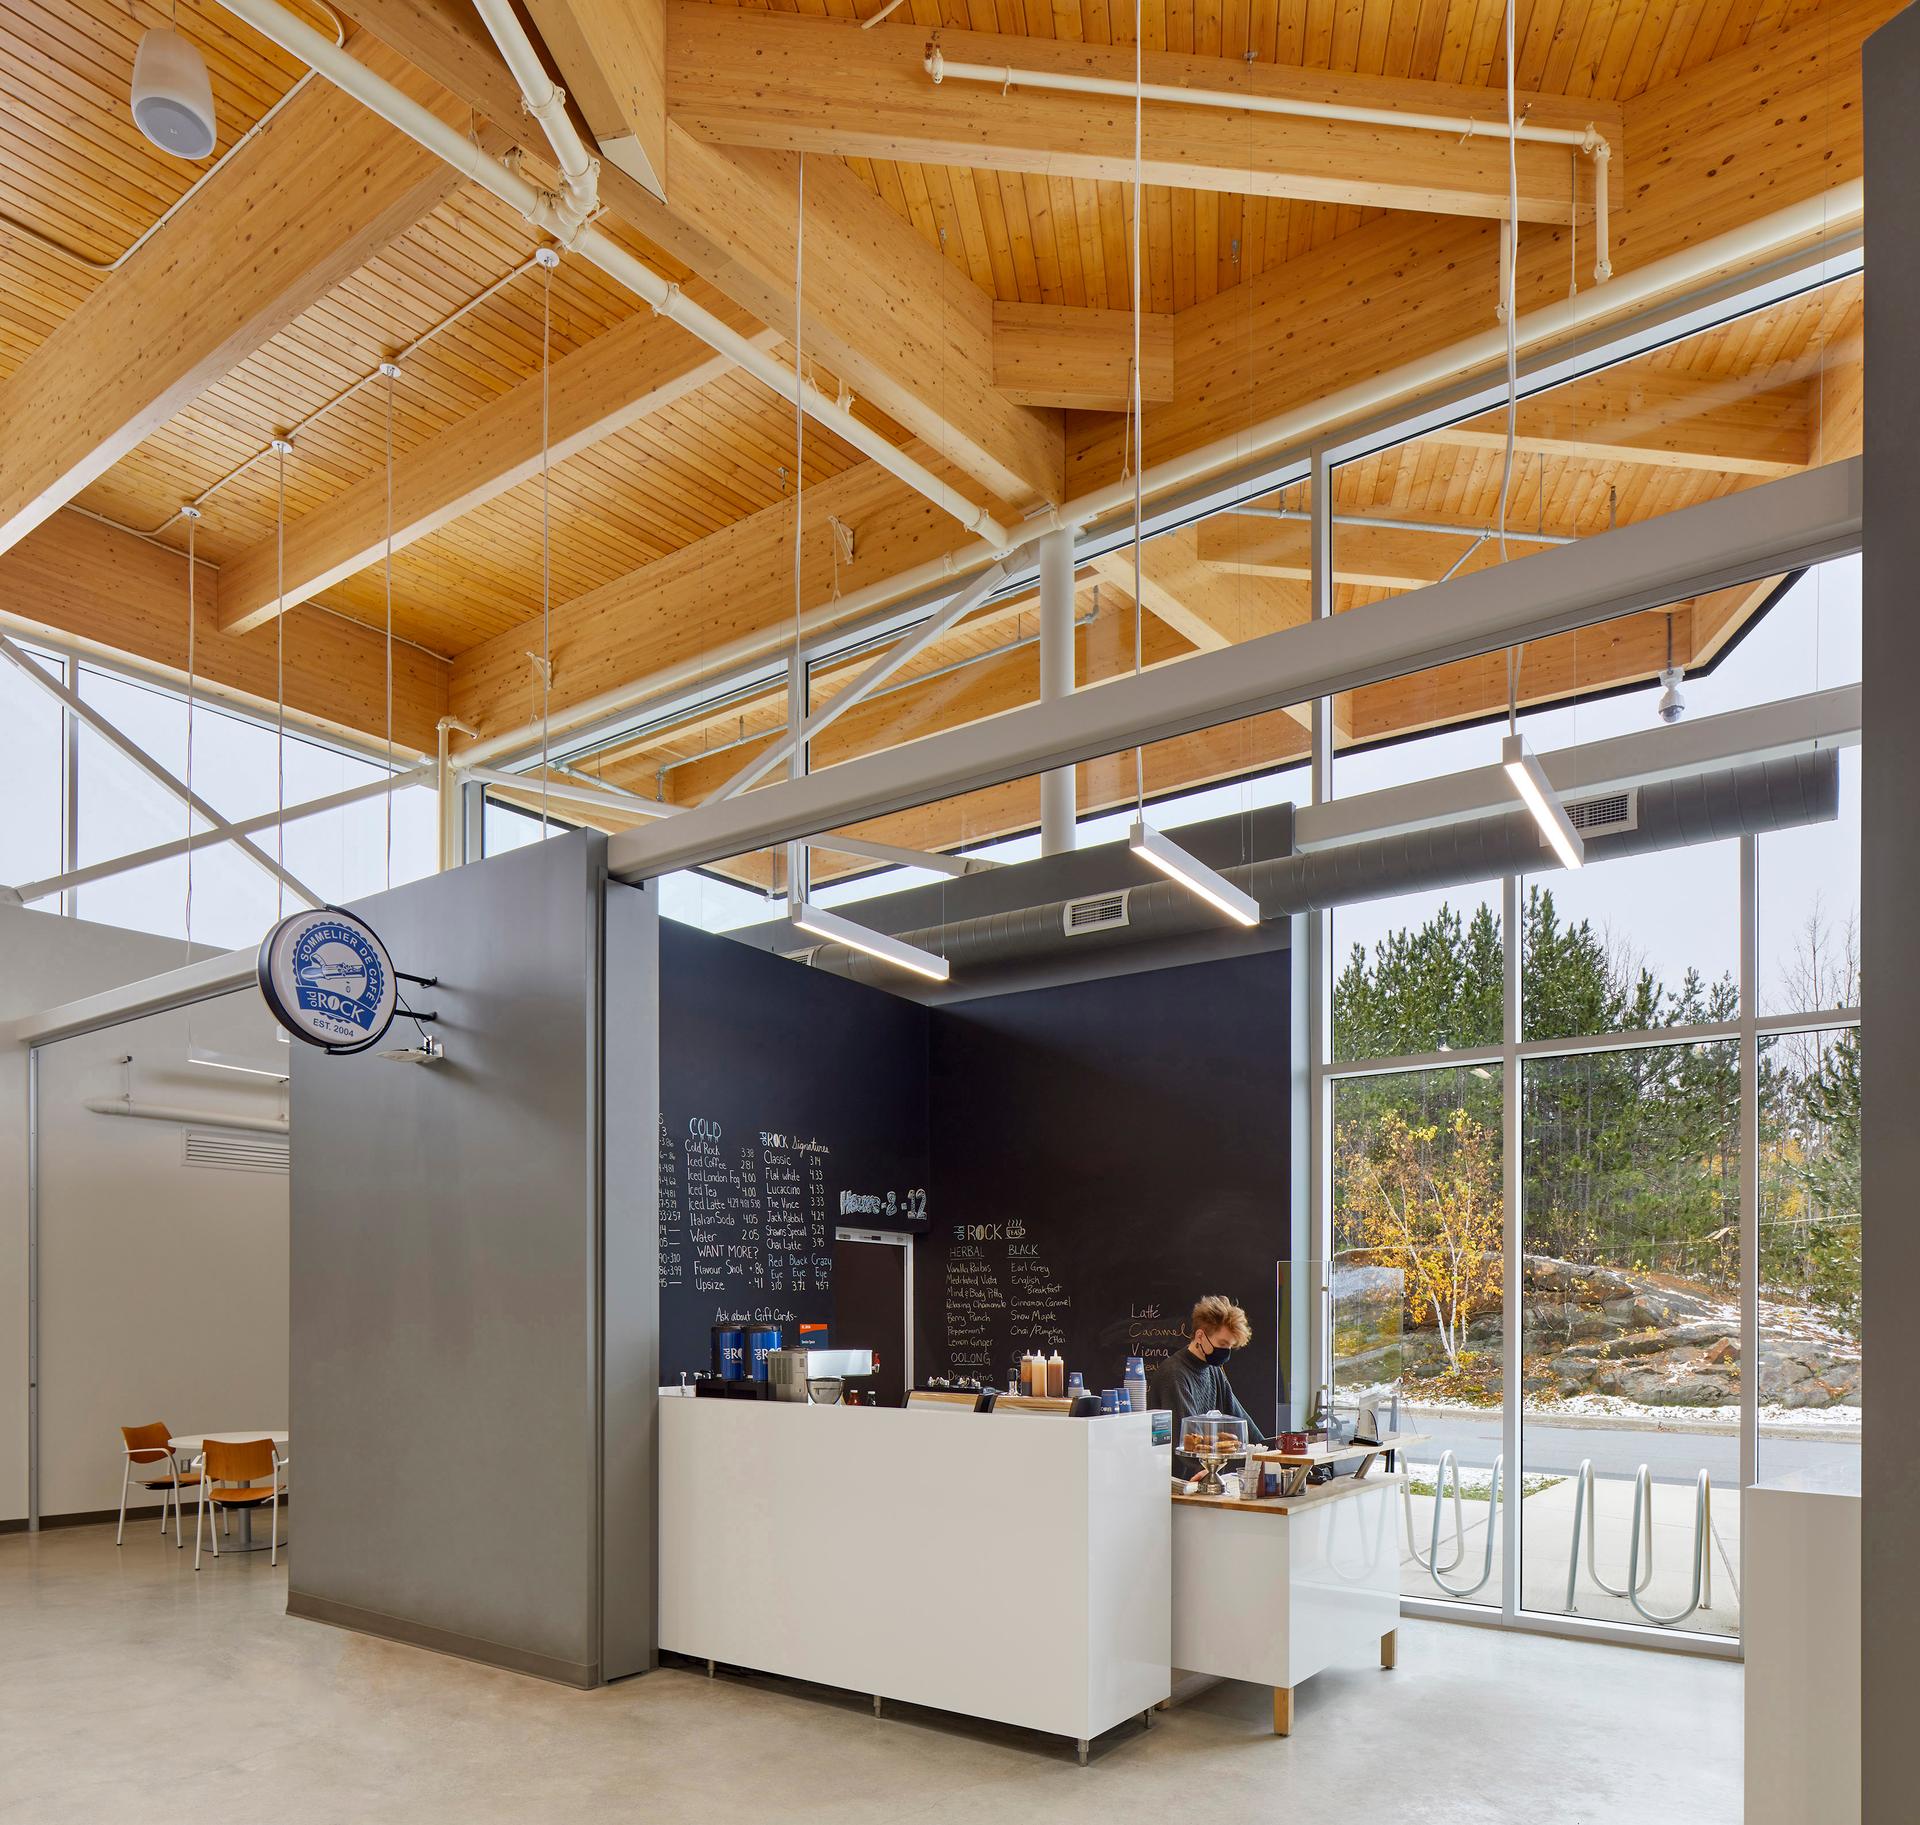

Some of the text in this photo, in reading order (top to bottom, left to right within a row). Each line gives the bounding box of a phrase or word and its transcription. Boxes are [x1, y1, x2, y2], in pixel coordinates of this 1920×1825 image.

[301, 929, 357, 962] SOMMELIER
[360, 948, 373, 965] DE
[306, 991, 365, 1023] old ROCK
[313, 1017, 354, 1037] EST. 2004
[689, 1117, 722, 1141] COLD
[684, 1139, 702, 1153] Cold
[703, 1142, 721, 1156] Rock
[767, 1132, 789, 1149] ROCK
[791, 1135, 830, 1158] Signatures
[686, 1153, 703, 1168] Iced
[704, 1156, 727, 1170] Coffee
[763, 1149, 792, 1166] Classic
[687, 1167, 703, 1181] Iced
[703, 1169, 728, 1183] London
[729, 1169, 741, 1189] Fog
[765, 1167, 780, 1181] Flat
[782, 1168, 800, 1182] white
[687, 1182, 703, 1196] Iced
[704, 1183, 717, 1197] Tea
[688, 1197, 705, 1211] Iced
[706, 1197, 727, 1211] Latte
[766, 1196, 779, 1208] The
[781, 1197, 800, 1209] Vince
[689, 1212, 715, 1226] Italian
[714, 1211, 736, 1226] Soda
[767, 1210, 782, 1223] Jack
[782, 1210, 804, 1224] Rabbit
[689, 1228, 718, 1243] Water
[967, 1223, 1003, 1241] ROCK
[696, 1244, 760, 1260] WANT MORE?
[783, 1238, 802, 1251] Latte
[949, 1245, 985, 1258] HERBAL
[1008, 1243, 1040, 1256] BLACK
[693, 1260, 723, 1275] Flavour
[725, 1259, 744, 1275] Shot
[768, 1252, 832, 1271] Red Black Crazy
[946, 1262, 969, 1274] Vanilla
[1010, 1260, 1051, 1278] Earl Grey
[770, 1267, 828, 1282] Eye Eye Eye
[1010, 1275, 1041, 1289] English
[695, 1278, 726, 1292] Upsize
[1027, 1282, 1063, 1295] Breakfast
[945, 1286, 964, 1299] Mind
[969, 1287, 987, 1302] Body
[1010, 1296, 1072, 1308] Cinnamon Caramel
[715, 1306, 730, 1322] Ask
[730, 1309, 751, 1322] about
[754, 1306, 772, 1322] Gift
[946, 1312, 991, 1326] Berry Punch
[1010, 1309, 1057, 1323] Snow Maple
[1010, 1325, 1029, 1336] Chai
[1128, 1321, 1192, 1340] Caramel
[946, 1336, 994, 1352] Lemon Ginger
[1131, 1342, 1171, 1359] Vienna
[950, 1352, 991, 1367] OOLONG
